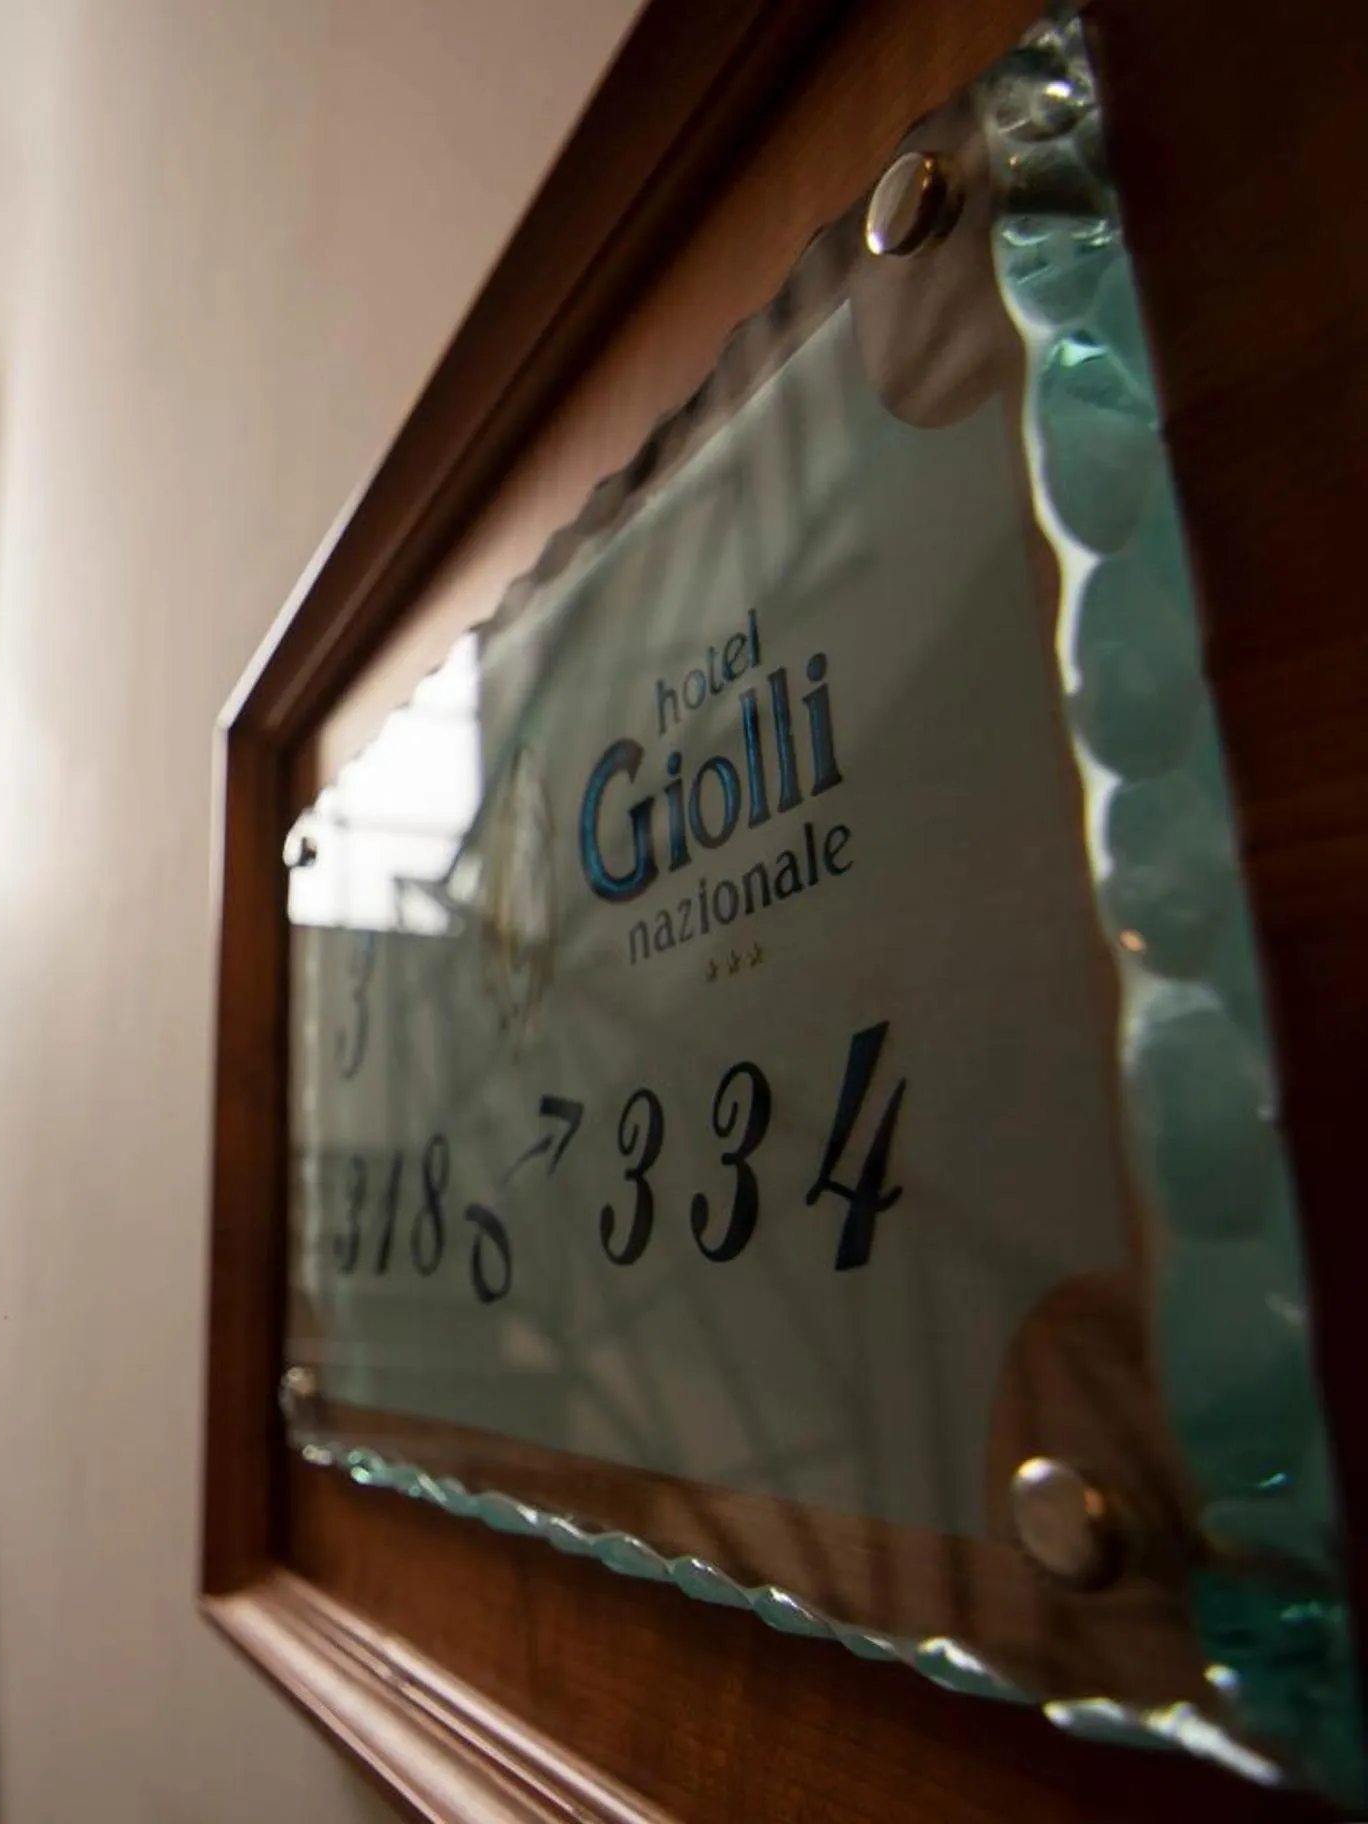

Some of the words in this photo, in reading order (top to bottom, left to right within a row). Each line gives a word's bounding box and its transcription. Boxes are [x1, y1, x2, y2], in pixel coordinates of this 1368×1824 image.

[655, 608, 761, 736] hotel
[579, 652, 843, 903] Giolli
[629, 822, 854, 965] nazionale
[334, 1133, 450, 1277] 318
[599, 1020, 907, 1272] 334
